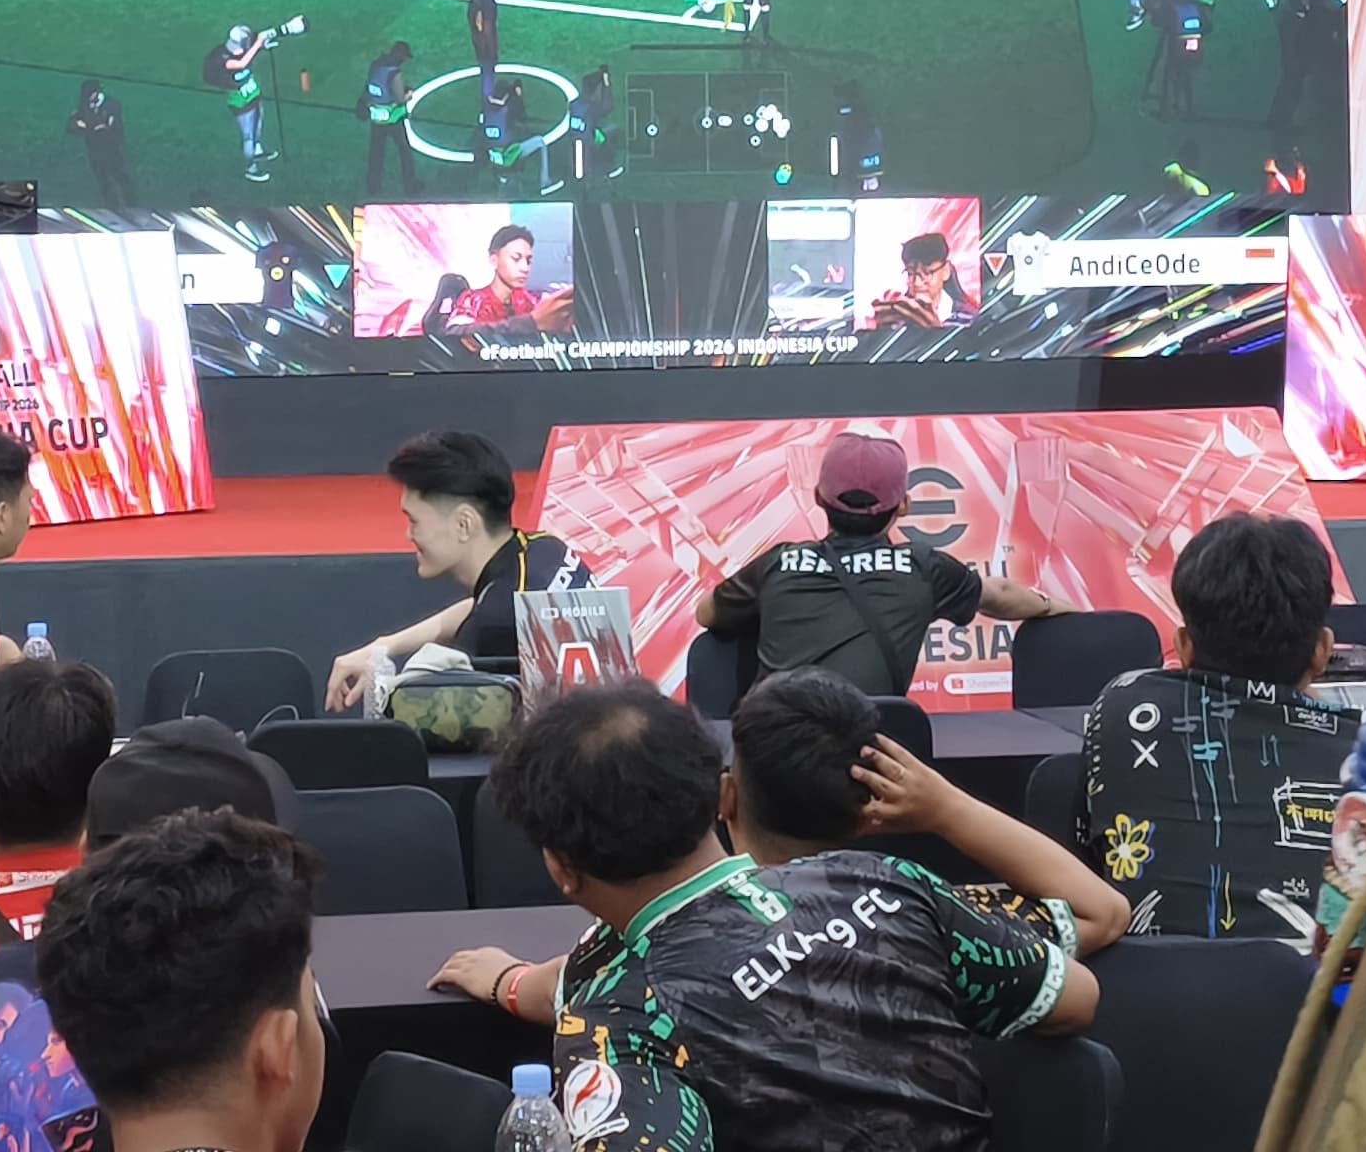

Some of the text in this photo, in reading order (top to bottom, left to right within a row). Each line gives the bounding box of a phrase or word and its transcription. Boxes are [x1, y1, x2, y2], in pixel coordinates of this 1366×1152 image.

[568, 339, 691, 359] CHAMPIONSHIP
[693, 338, 734, 356] 2026
[737, 337, 824, 354] INDONESIA
[826, 335, 858, 352] CUP
[11, 398, 40, 412] 2026
[48, 416, 109, 451] CUP
[561, 605, 606, 618] MOBILE
[851, 887, 902, 930] FC
